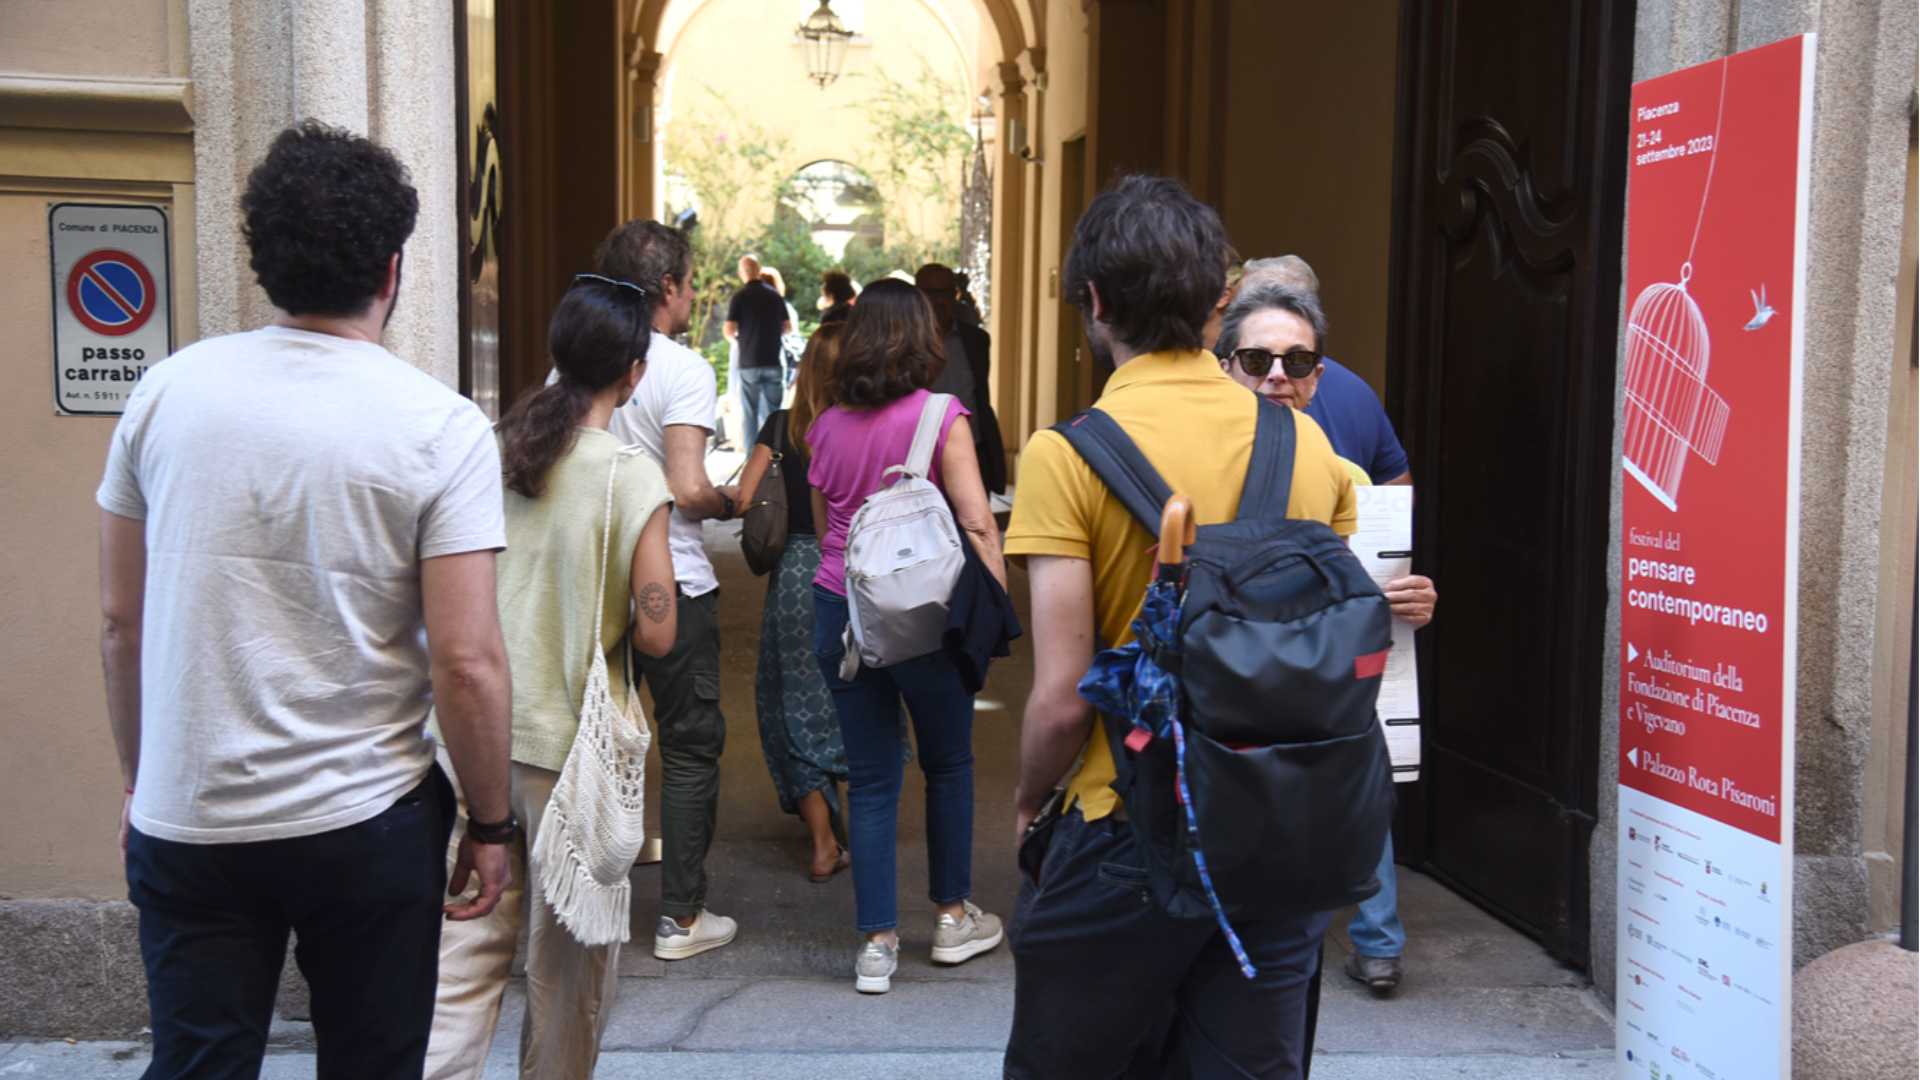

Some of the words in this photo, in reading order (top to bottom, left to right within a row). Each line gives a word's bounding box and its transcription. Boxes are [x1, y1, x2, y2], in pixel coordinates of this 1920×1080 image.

[1637, 102, 1680, 122] Piacenza
[1635, 144, 1686, 165] settembre
[1687, 135, 1713, 155] 2023
[59, 222, 96, 232] Comune
[99, 224, 109, 233] di
[112, 224, 159, 235] PIACENZA
[82, 347, 145, 362] passo
[65, 365, 148, 381] carrabi
[1629, 527, 1663, 549] festival
[1664, 531, 1681, 551] del
[1629, 557, 1696, 585] pensare
[1628, 588, 1768, 633] contemporaneo
[1643, 648, 1712, 684] Auditorium
[1713, 662, 1744, 692] della
[1627, 671, 1690, 708] Fondazione
[1692, 687, 1705, 712] di
[1706, 691, 1761, 729] Piacenza
[1626, 705, 1635, 721] e
[1636, 701, 1687, 736] Vigevano
[1642, 750, 1687, 784] Palazzo
[1688, 766, 1720, 796] Rota
[1721, 777, 1777, 817] Pisaroni
